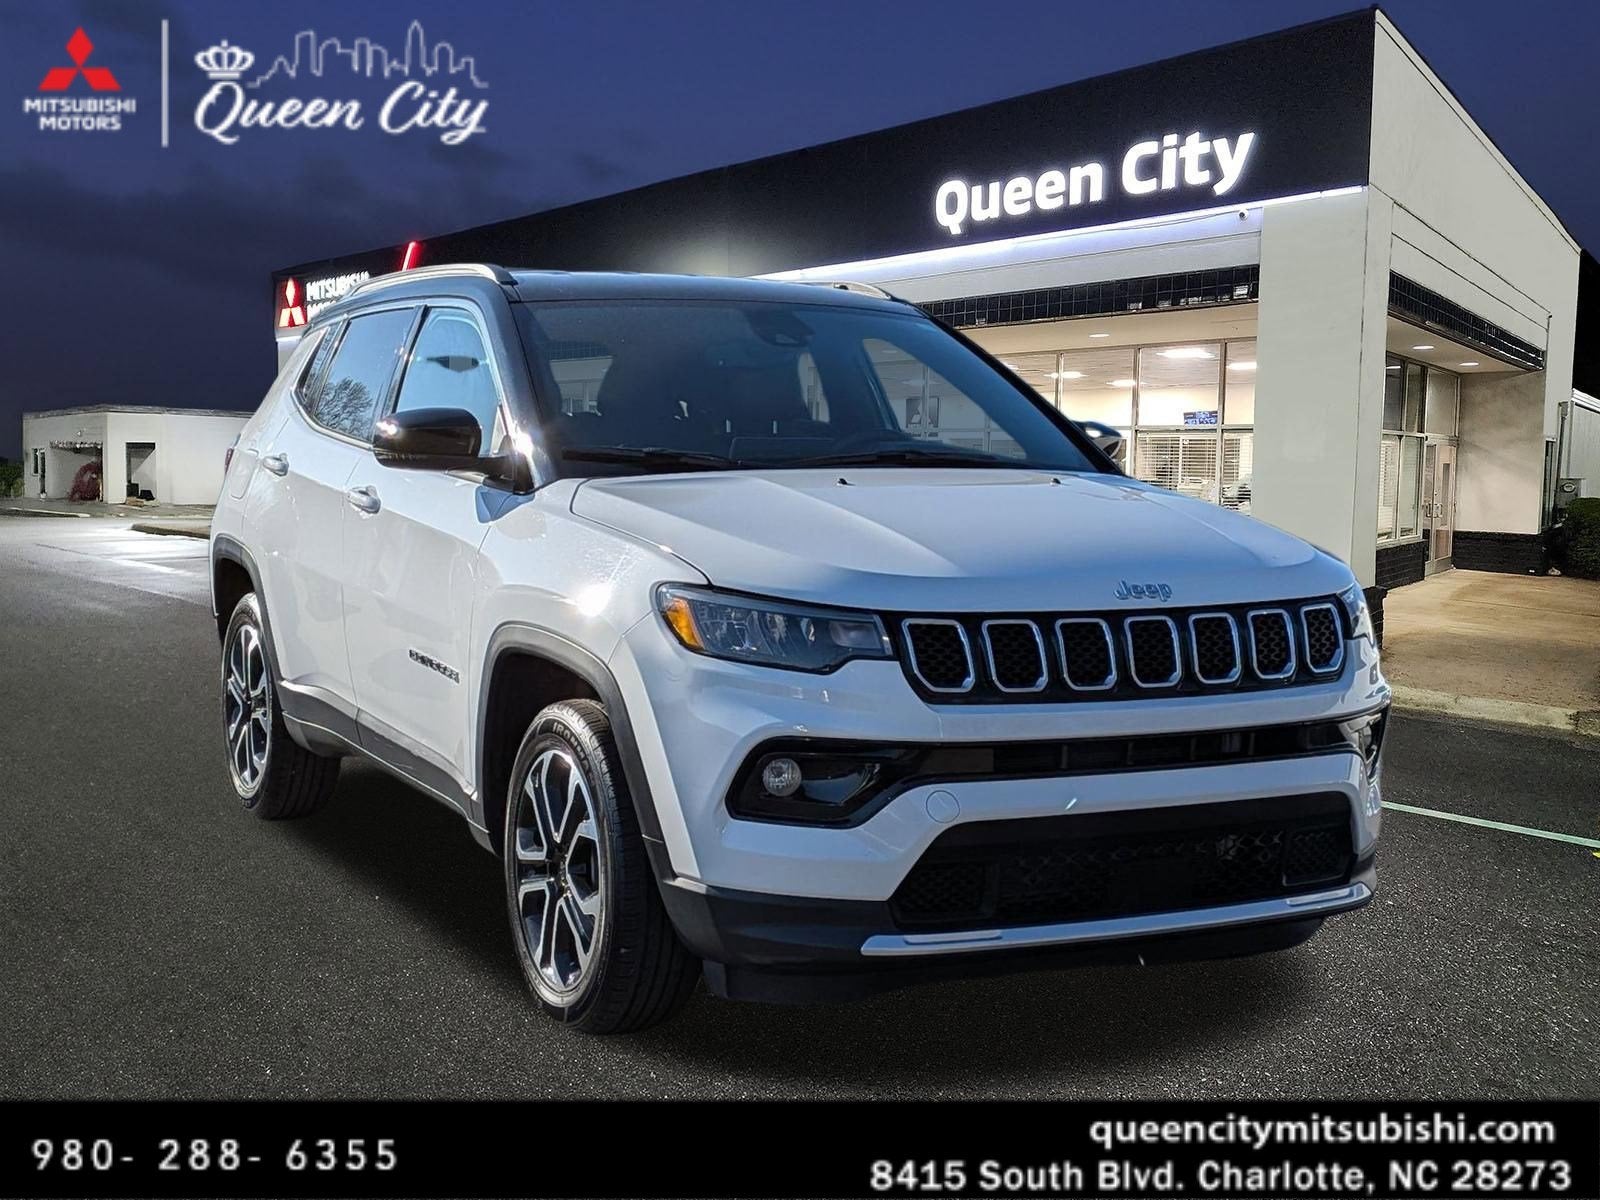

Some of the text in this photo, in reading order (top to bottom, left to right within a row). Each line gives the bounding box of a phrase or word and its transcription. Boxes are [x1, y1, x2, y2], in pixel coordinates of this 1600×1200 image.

[935, 131, 1256, 235] Queen City
[1113, 579, 1172, 602] Jeep
